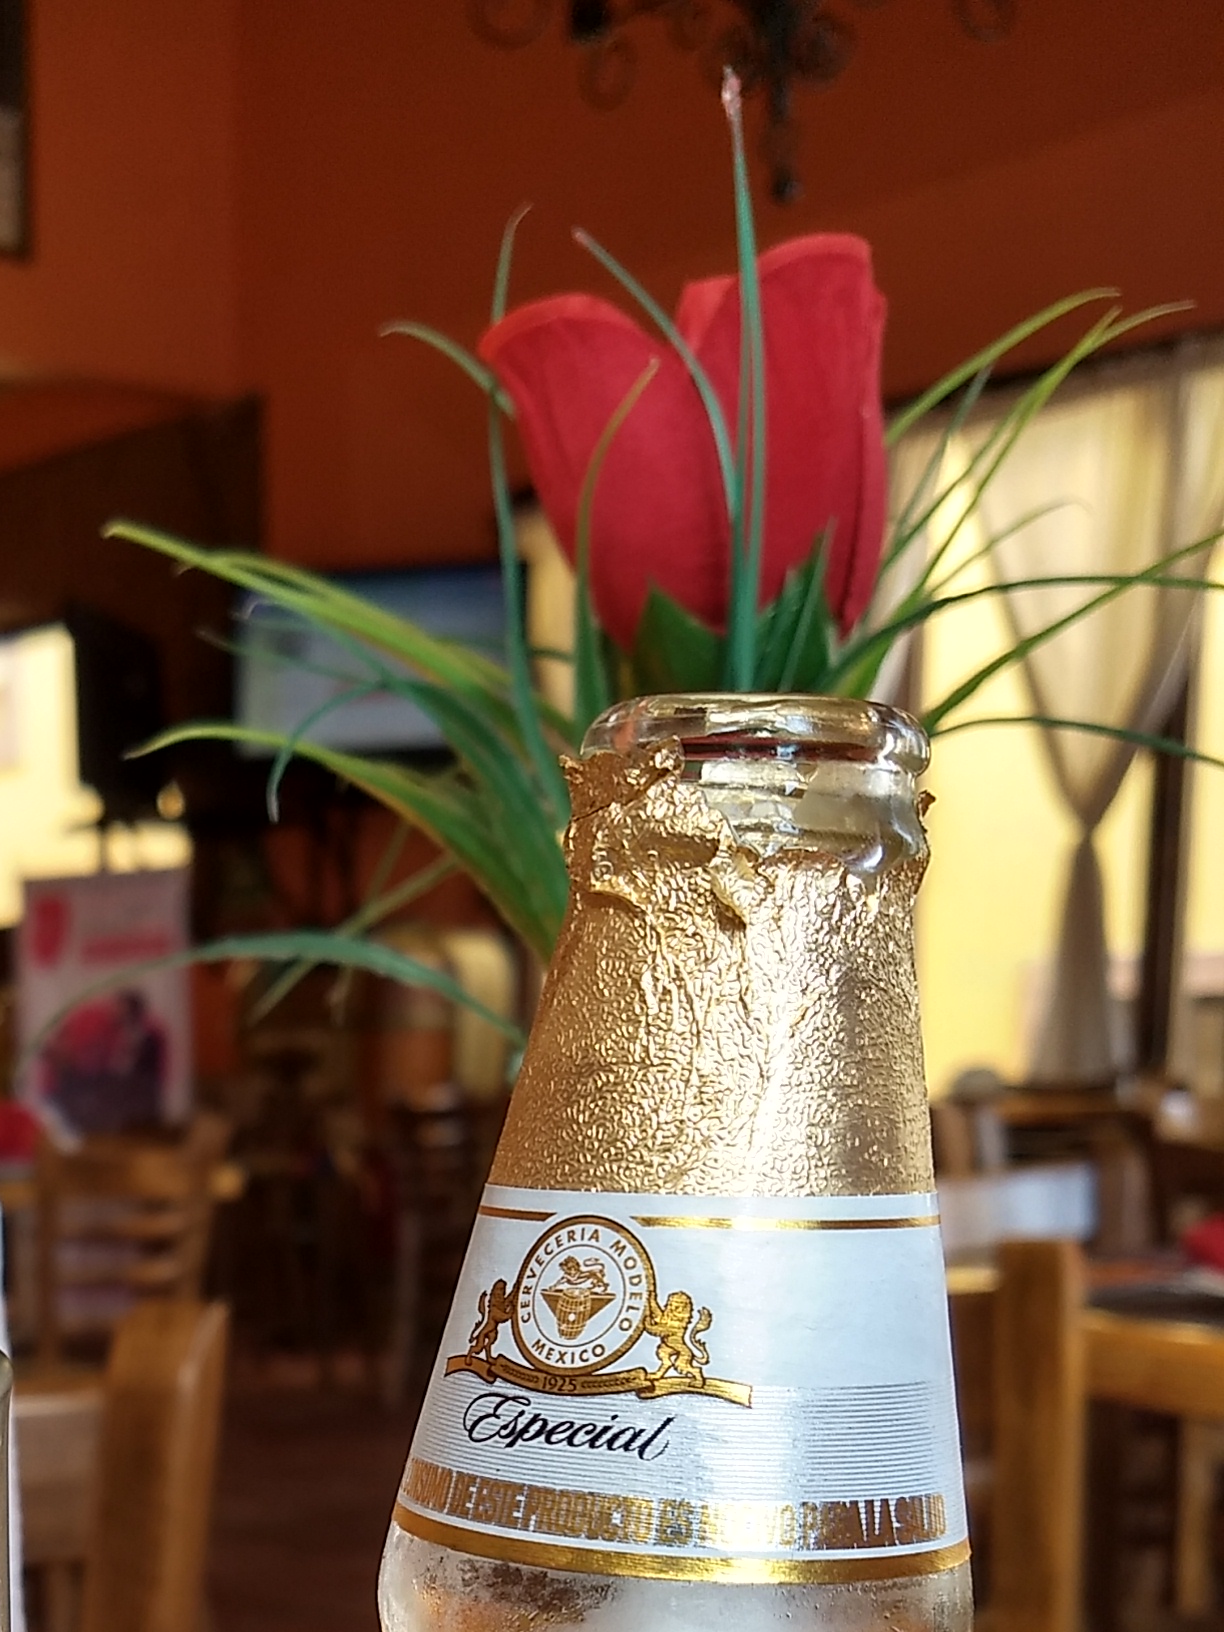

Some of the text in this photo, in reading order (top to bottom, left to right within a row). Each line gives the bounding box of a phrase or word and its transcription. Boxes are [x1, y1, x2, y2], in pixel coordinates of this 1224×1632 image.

[609, 1239, 644, 1332] MODELO
[531, 1338, 606, 1365] MEXICO
[540, 1375, 578, 1393] 1925
[462, 1392, 676, 1462] Especial
